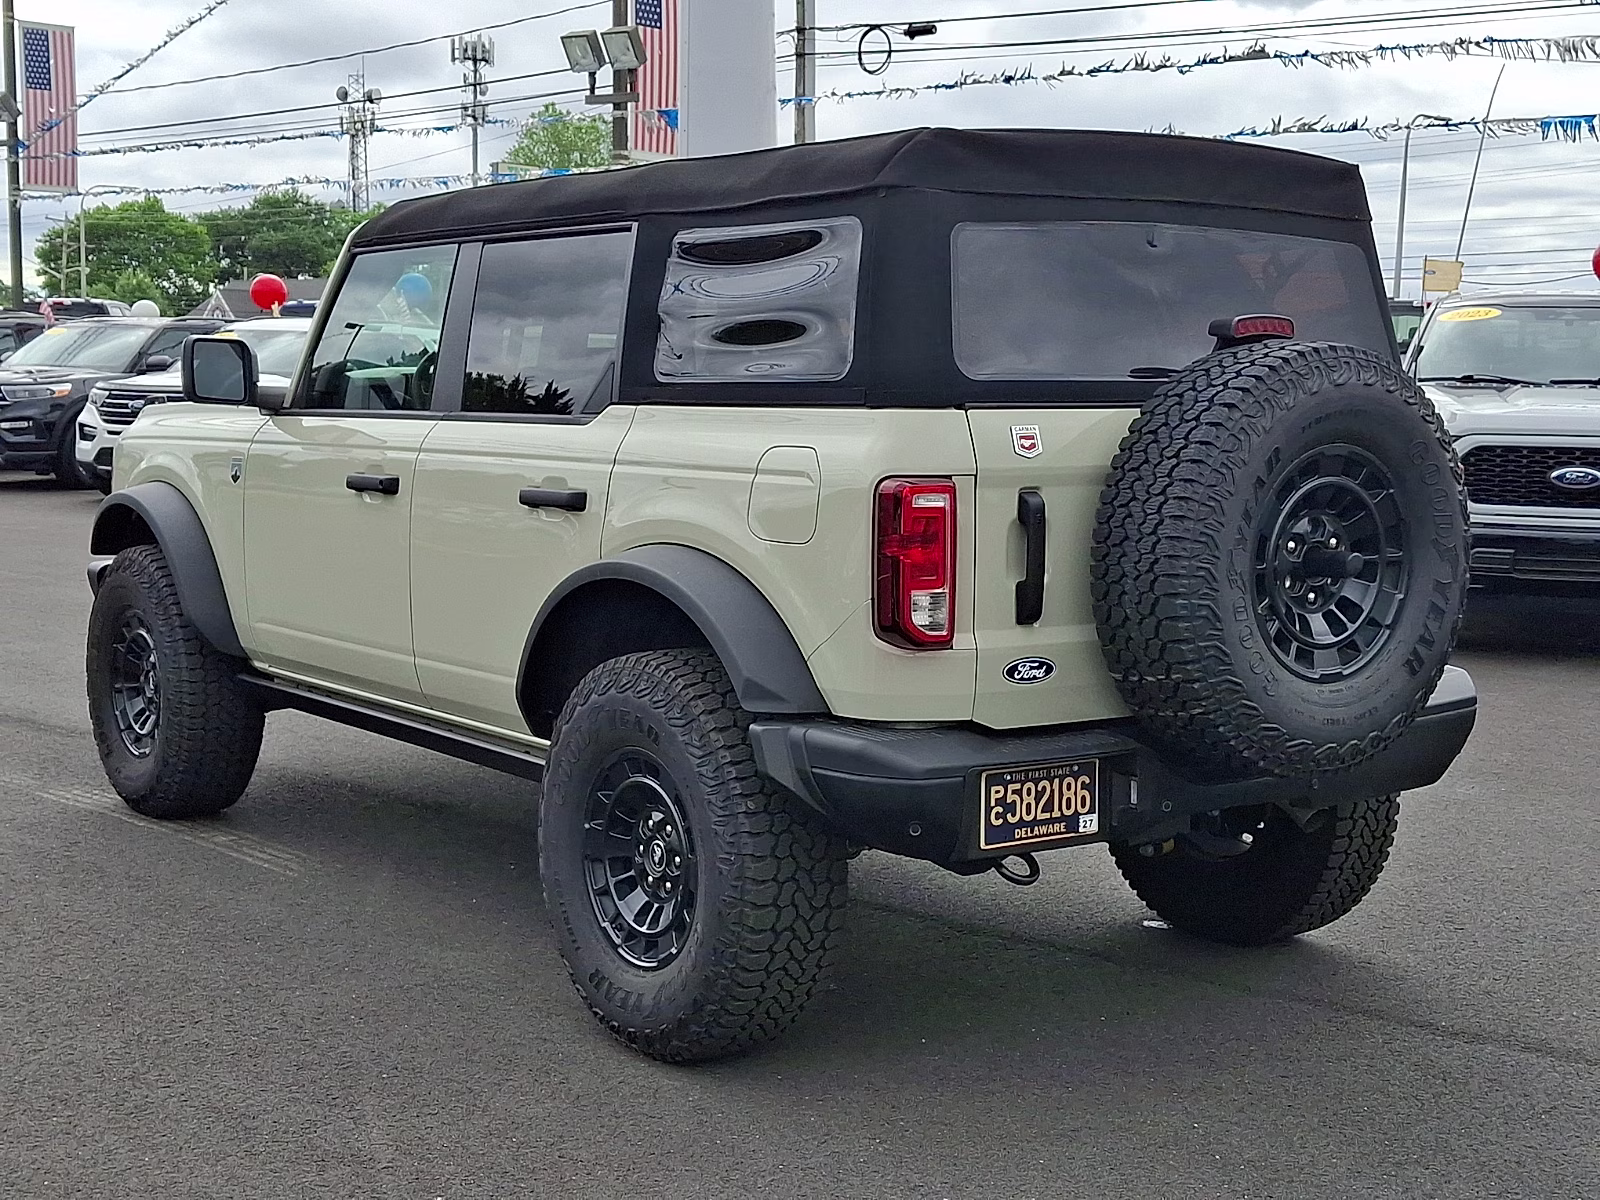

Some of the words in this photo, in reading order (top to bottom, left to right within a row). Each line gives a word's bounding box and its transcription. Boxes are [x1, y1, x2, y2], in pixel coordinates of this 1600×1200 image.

[1449, 309, 1492, 320] 2023
[1562, 471, 1594, 484] Ford
[1014, 662, 1047, 679] Ford
[1012, 773, 1026, 781] THE
[1028, 769, 1047, 779] FIRST
[1050, 766, 1070, 776] STATE
[1014, 822, 1067, 839] DELAWARE
[1082, 818, 1094, 829] 27
